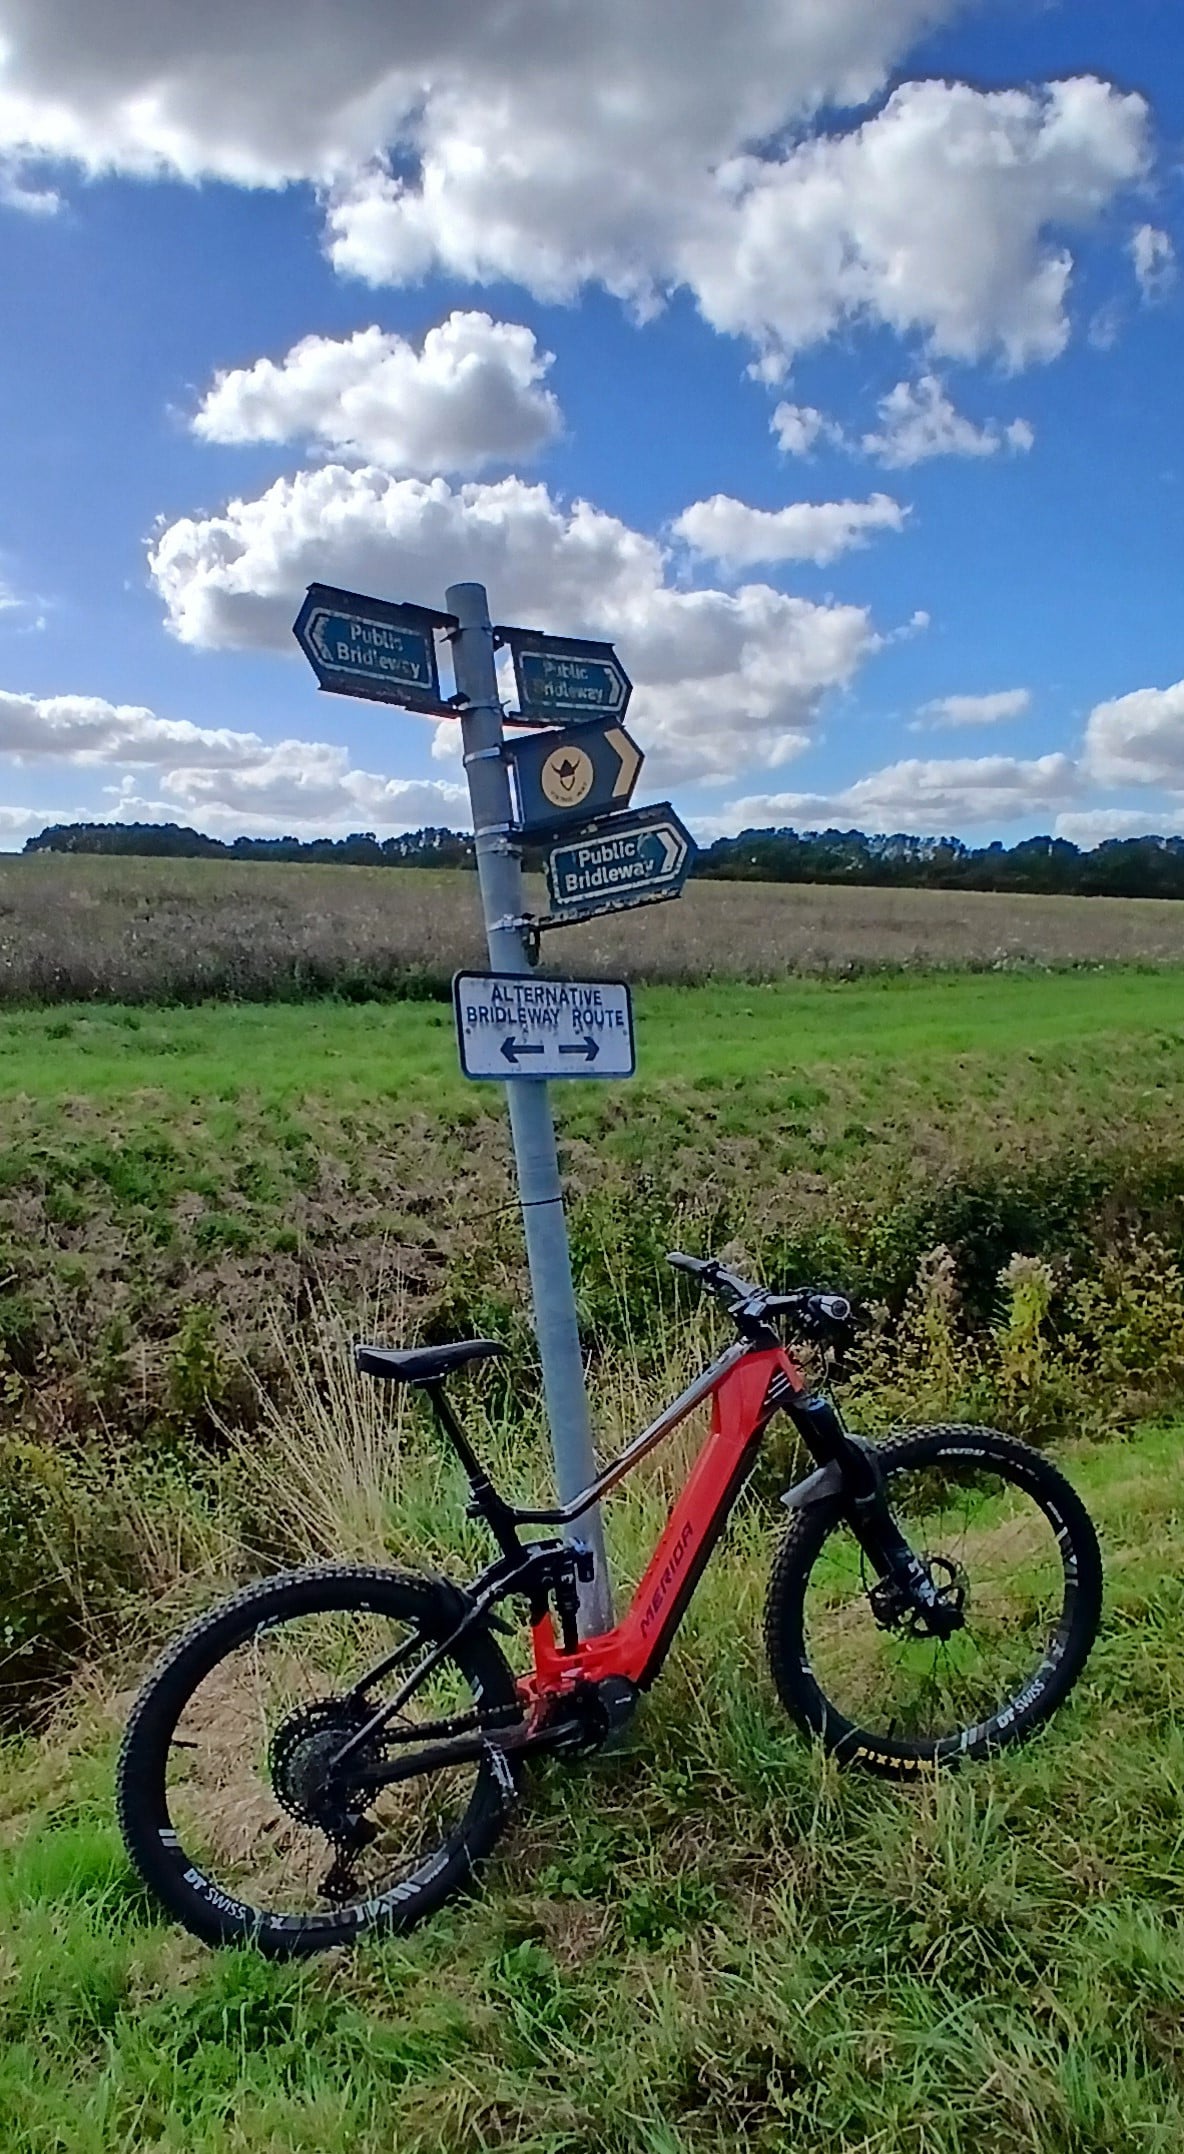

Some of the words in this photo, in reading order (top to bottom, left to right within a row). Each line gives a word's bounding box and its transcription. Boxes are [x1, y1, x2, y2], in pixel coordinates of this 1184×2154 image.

[351, 625, 403, 651] Public
[535, 680, 603, 703] ridlway
[578, 841, 635, 868] Public
[565, 860, 654, 892] Bridleway
[491, 983, 603, 1006] ALTERNATIVE
[466, 1006, 560, 1025] BRIDLEWAY
[572, 1009, 624, 1028] ROUTE
[640, 1521, 694, 1639] MERIDA
[1015, 1679, 1045, 1713] SWISS
[183, 1868, 207, 1890] DT
[204, 1887, 247, 1920] SWISS
